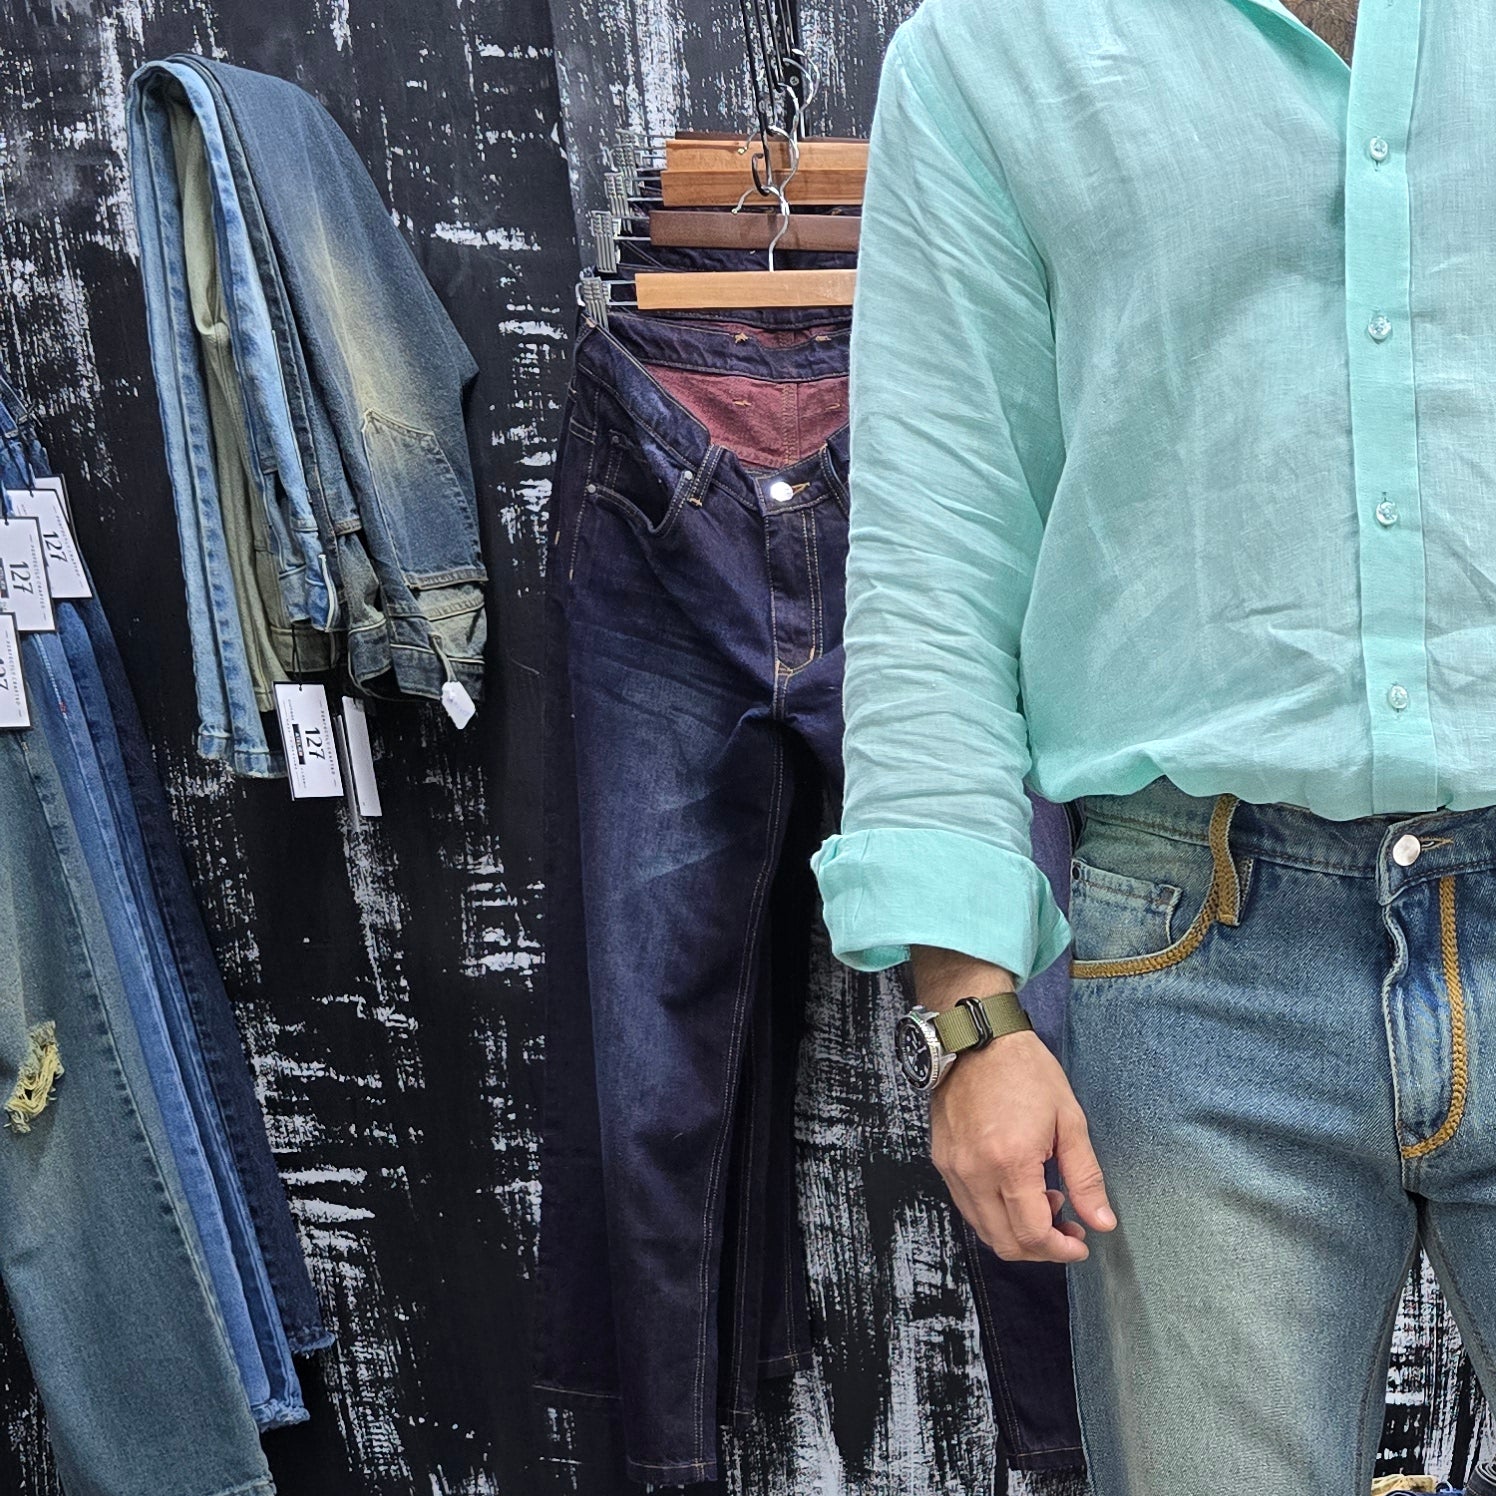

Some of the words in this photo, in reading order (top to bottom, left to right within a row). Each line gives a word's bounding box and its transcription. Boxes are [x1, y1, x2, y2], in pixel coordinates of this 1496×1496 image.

[43, 531, 68, 563] 127
[9, 561, 34, 595] 127
[304, 727, 326, 760] 127
